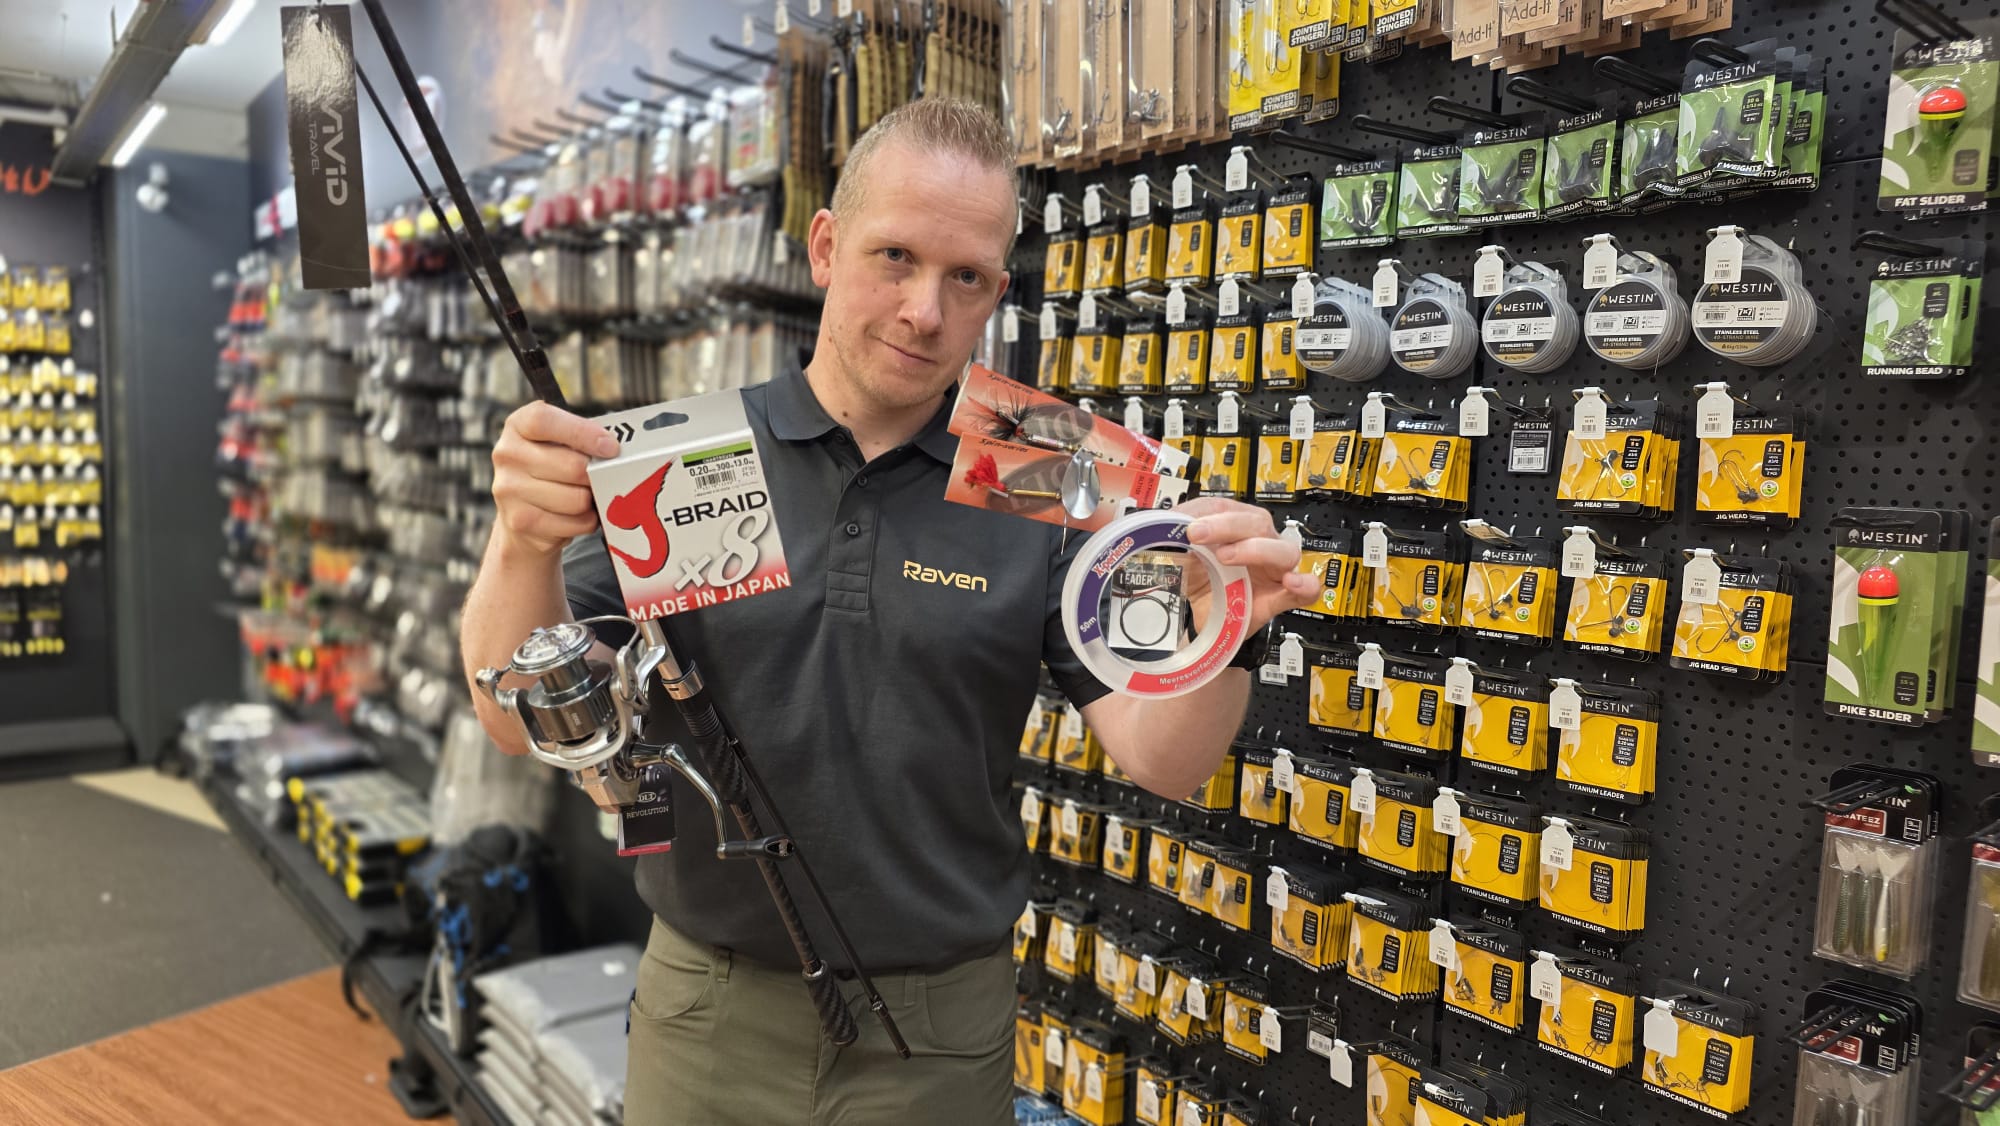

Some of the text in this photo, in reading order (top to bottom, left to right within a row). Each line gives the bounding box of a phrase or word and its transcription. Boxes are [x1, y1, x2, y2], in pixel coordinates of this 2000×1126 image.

[1377, 9, 1411, 27] JOINTED
[1291, 22, 1325, 38] JOINTED
[1703, 63, 1757, 83] WESTIN
[1264, 93, 1295, 106] JOINTED
[1565, 110, 1603, 128] WESTIN
[1484, 127, 1530, 142] WESTIN
[308, 120, 320, 176] TRAVEL
[1343, 161, 1382, 174] WESTIN
[1563, 200, 1583, 212] FLOAT
[1895, 194, 1966, 207] FAT SLIDER
[1482, 214, 1503, 223] FLOAT
[1503, 211, 1537, 222] WEIGHTS
[1890, 259, 1953, 272] WESTIN
[1721, 283, 1774, 294] WESTIN
[1608, 294, 1655, 304] WESTIN
[1503, 302, 1544, 312] WESTIN
[1311, 314, 1343, 323] WESTIN
[1408, 311, 1442, 321] WESTIN
[1867, 367, 1943, 376] RUNNING BEAD
[1405, 421, 1447, 432] WESTIN
[1519, 422, 1550, 431] WESTIN
[1605, 416, 1639, 426] ESTIN
[1733, 419, 1774, 430] ESTIN
[1268, 424, 1290, 433] WESTI
[1306, 539, 1338, 549] WESTIN
[1861, 531, 1924, 545] WESTIN
[1394, 546, 1432, 556] WESTIN
[1491, 551, 1534, 562] WESTIN
[903, 560, 987, 593] Raven
[1721, 574, 1761, 585] ESTIN
[629, 572, 792, 621] MADE IN JAPAN
[1079, 616, 1097, 633] 50m
[1327, 656, 1358, 666] WESTIN
[1700, 663, 1720, 671] HEAD
[1398, 669, 1434, 681] WESTIN
[1487, 682, 1526, 696] WESTIN
[1585, 700, 1631, 713] WESTIN
[1839, 704, 1913, 723] PIKE SLIDER
[1383, 741, 1427, 755] TITANIUM LEADER
[1309, 767, 1341, 780] WESTIN
[1471, 760, 1519, 776] TITANIUM LEADER
[1379, 785, 1412, 800] WESTIN
[1568, 783, 1625, 800] TITANIUM LEADER
[1476, 808, 1515, 825] WESTIN
[1573, 834, 1606, 851] ESTIN
[1388, 865, 1407, 876] LEADER
[1461, 886, 1510, 905] TITANIUM LEADER
[1366, 907, 1398, 924] WESTIN
[1551, 912, 1606, 934] TITANIUM LEADER
[1467, 935, 1506, 953] WESTIN
[1567, 966, 1611, 986] WESTIN
[1445, 1004, 1512, 1035] FLUOROCARBON LEADER
[1538, 1042, 1613, 1075] FLUOROCARBON LEADER
[1643, 1083, 1728, 1121] FLUOROCARBON LEADER
